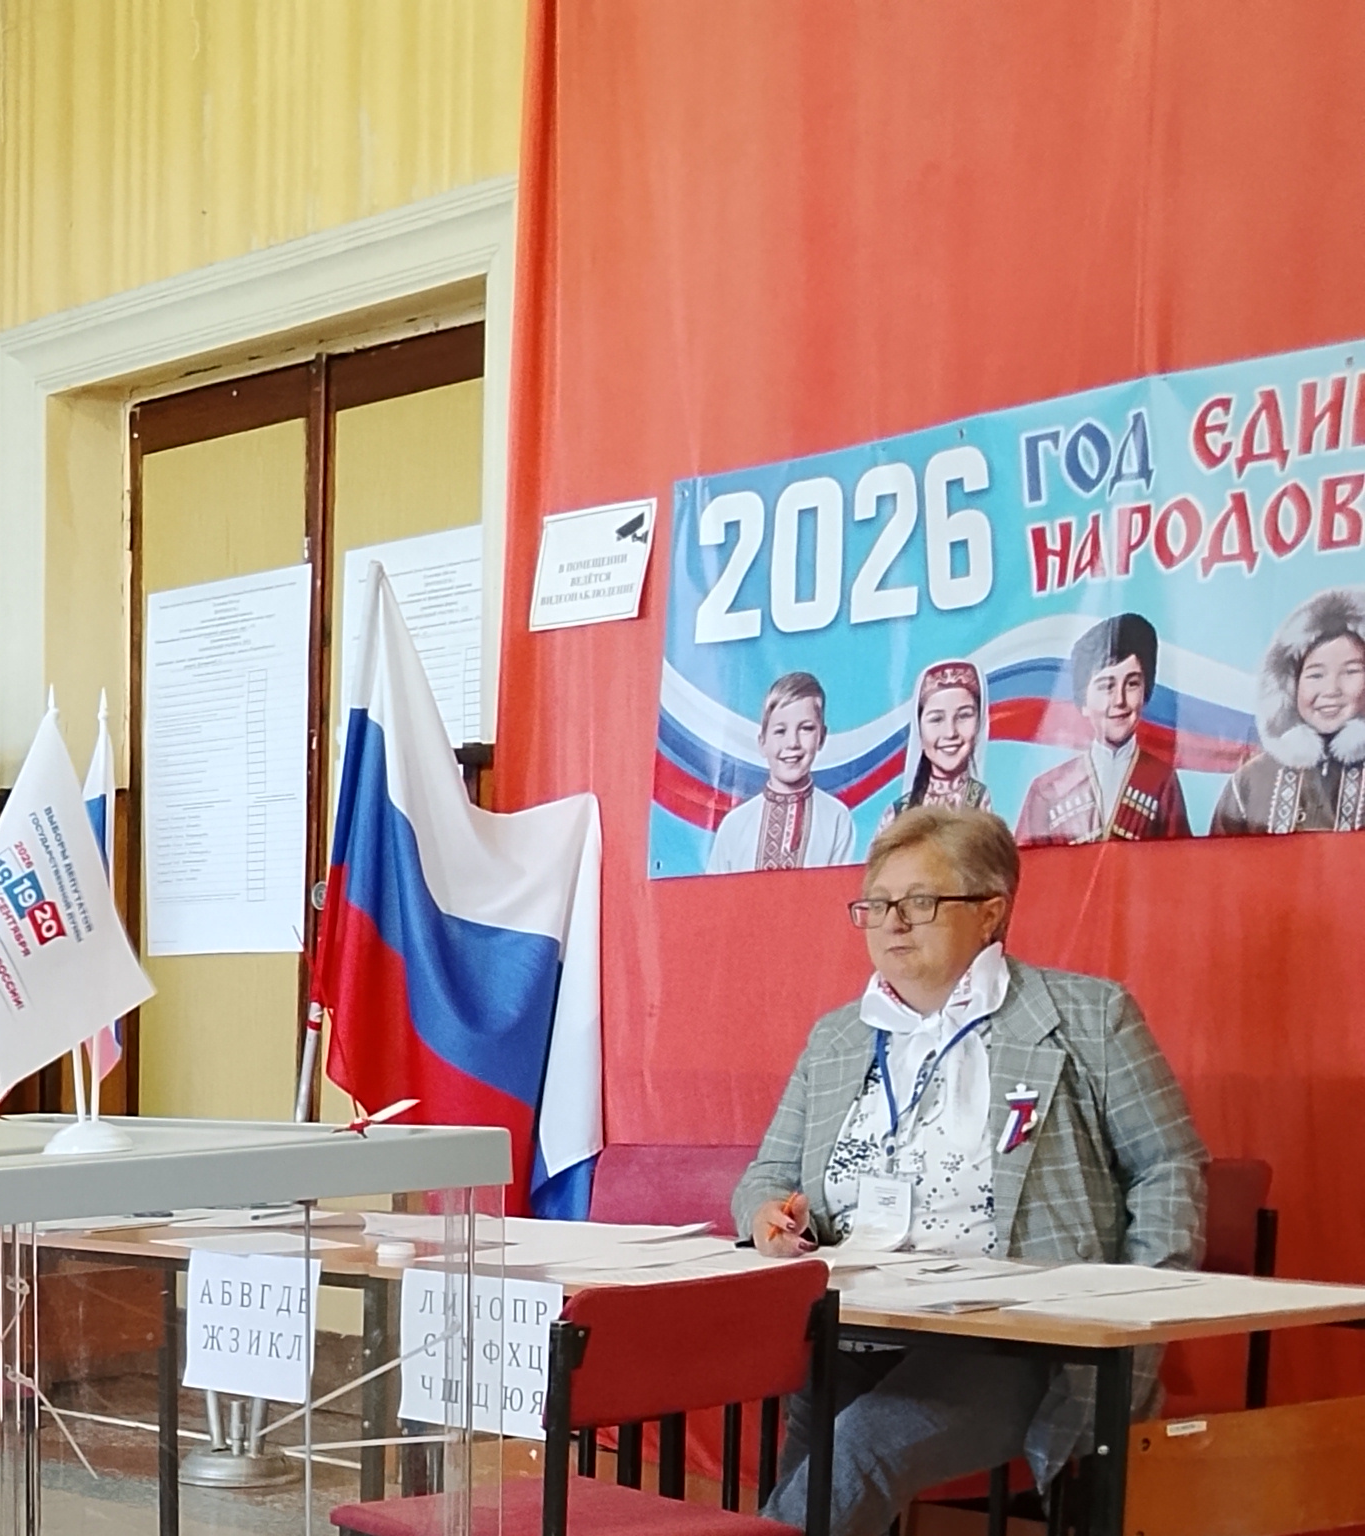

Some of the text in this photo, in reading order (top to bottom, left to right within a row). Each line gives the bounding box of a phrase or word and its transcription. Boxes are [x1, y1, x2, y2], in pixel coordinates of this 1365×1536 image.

[1025, 411, 1154, 503] ГОД
[566, 553, 628, 573] ПОМЕЩЕНИИ
[694, 446, 993, 645] 2026
[1030, 473, 1365, 593] НАРОДОВ
[540, 584, 635, 606] ВИДЕОНАБЛЮДЕНИЕ
[570, 571, 611, 587] ВЕДЁТСЯ
[14, 841, 34, 869] 2026
[28, 811, 72, 912] ГОСУДАРСТВЕННОЙ
[44, 805, 93, 933] ВЫБОРЫ ДЕПУТАТОВ
[13, 877, 37, 907] 19
[34, 904, 59, 938] 20
